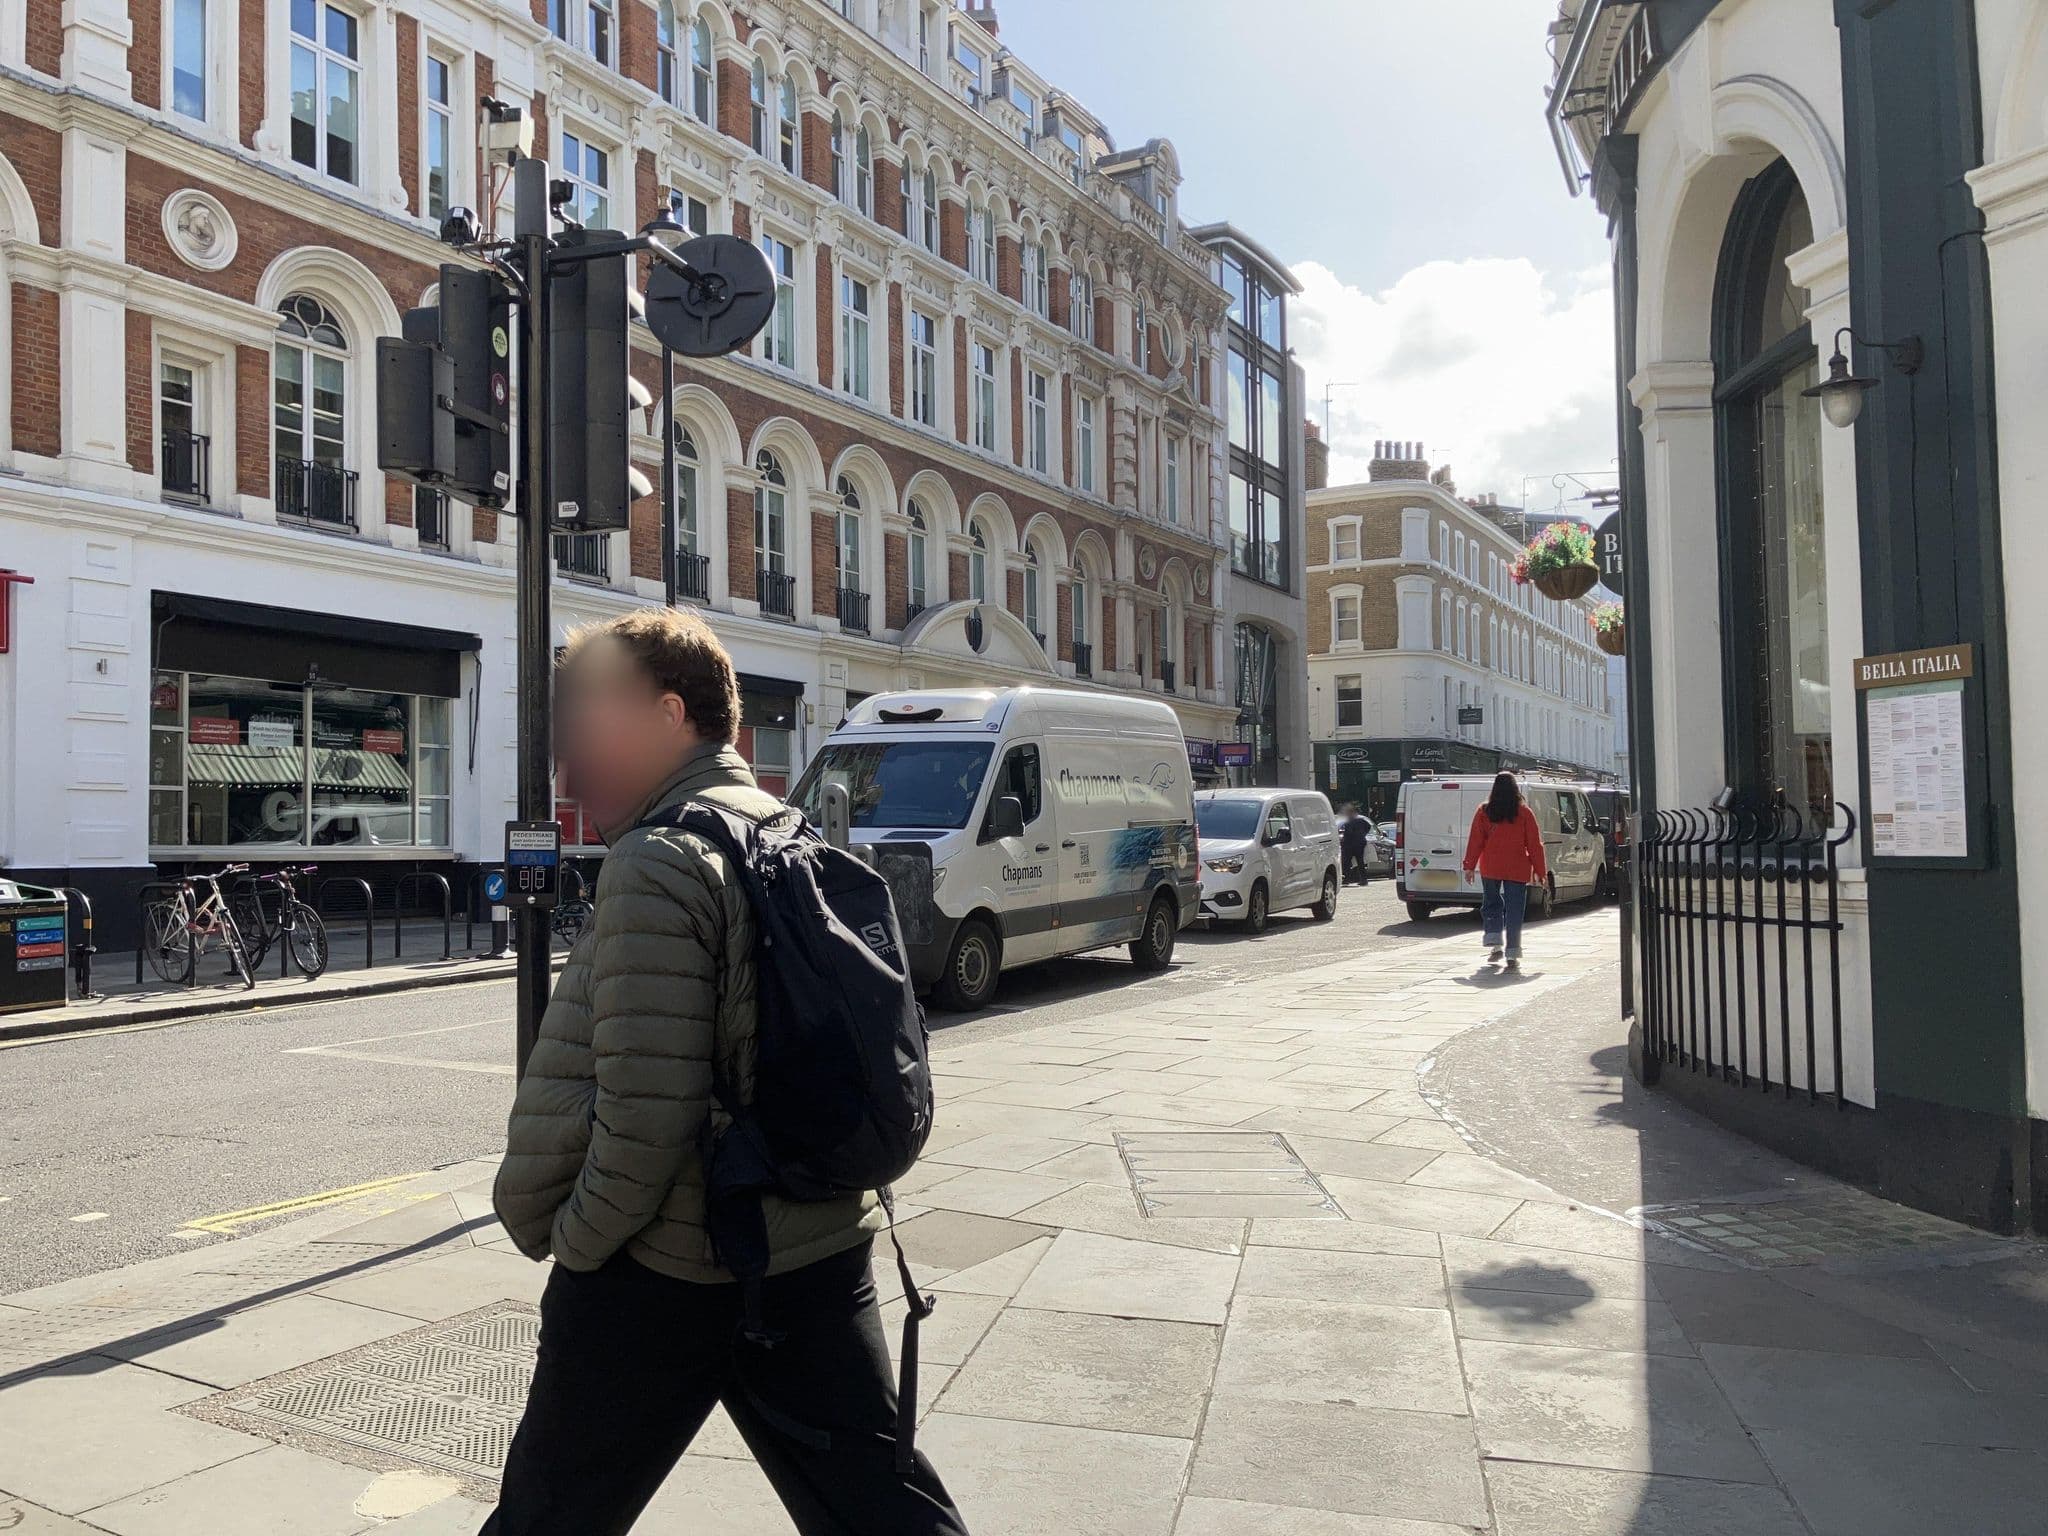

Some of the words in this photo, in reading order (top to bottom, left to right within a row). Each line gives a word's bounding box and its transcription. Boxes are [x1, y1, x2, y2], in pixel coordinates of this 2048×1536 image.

[1861, 658, 1908, 681] BELLA
[1912, 653, 1962, 675] ITALIA
[1060, 768, 1123, 805] Chapmans
[1002, 863, 1042, 885] Chapmans
